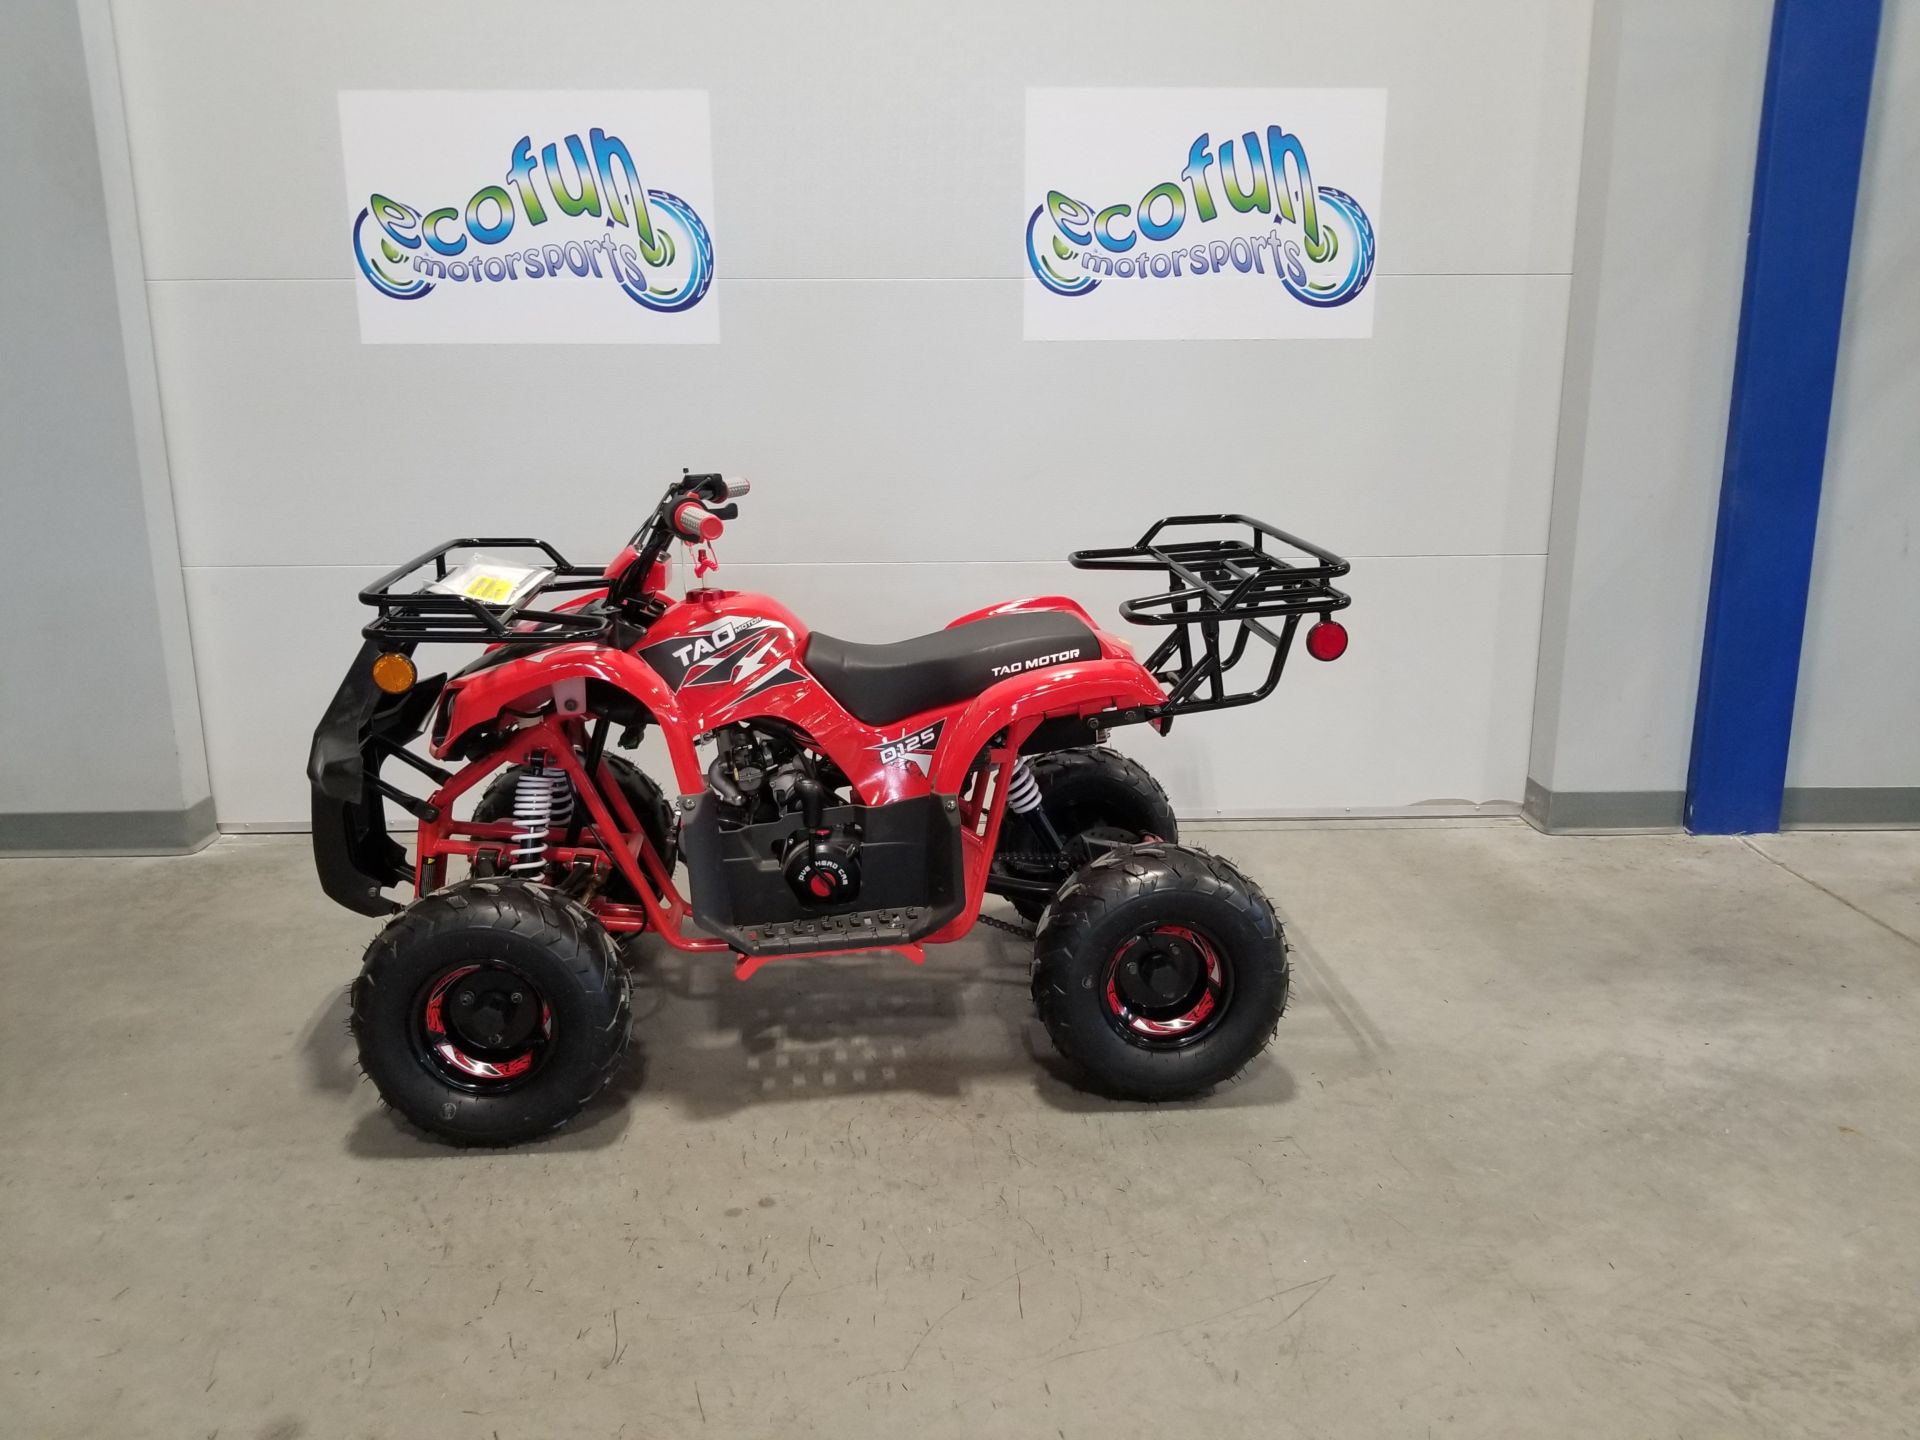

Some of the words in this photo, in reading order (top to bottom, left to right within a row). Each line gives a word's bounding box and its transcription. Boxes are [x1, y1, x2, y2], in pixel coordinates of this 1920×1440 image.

[371, 128, 656, 251] ecofun
[1046, 125, 1320, 246] ecofun
[413, 232, 648, 292] motorsports
[1081, 229, 1308, 287] motorsports
[672, 622, 735, 667] TAO
[734, 616, 762, 634] MOTOR
[991, 662, 1022, 676] TAO
[1025, 649, 1080, 669] MOTOR
[880, 728, 935, 765] D125
